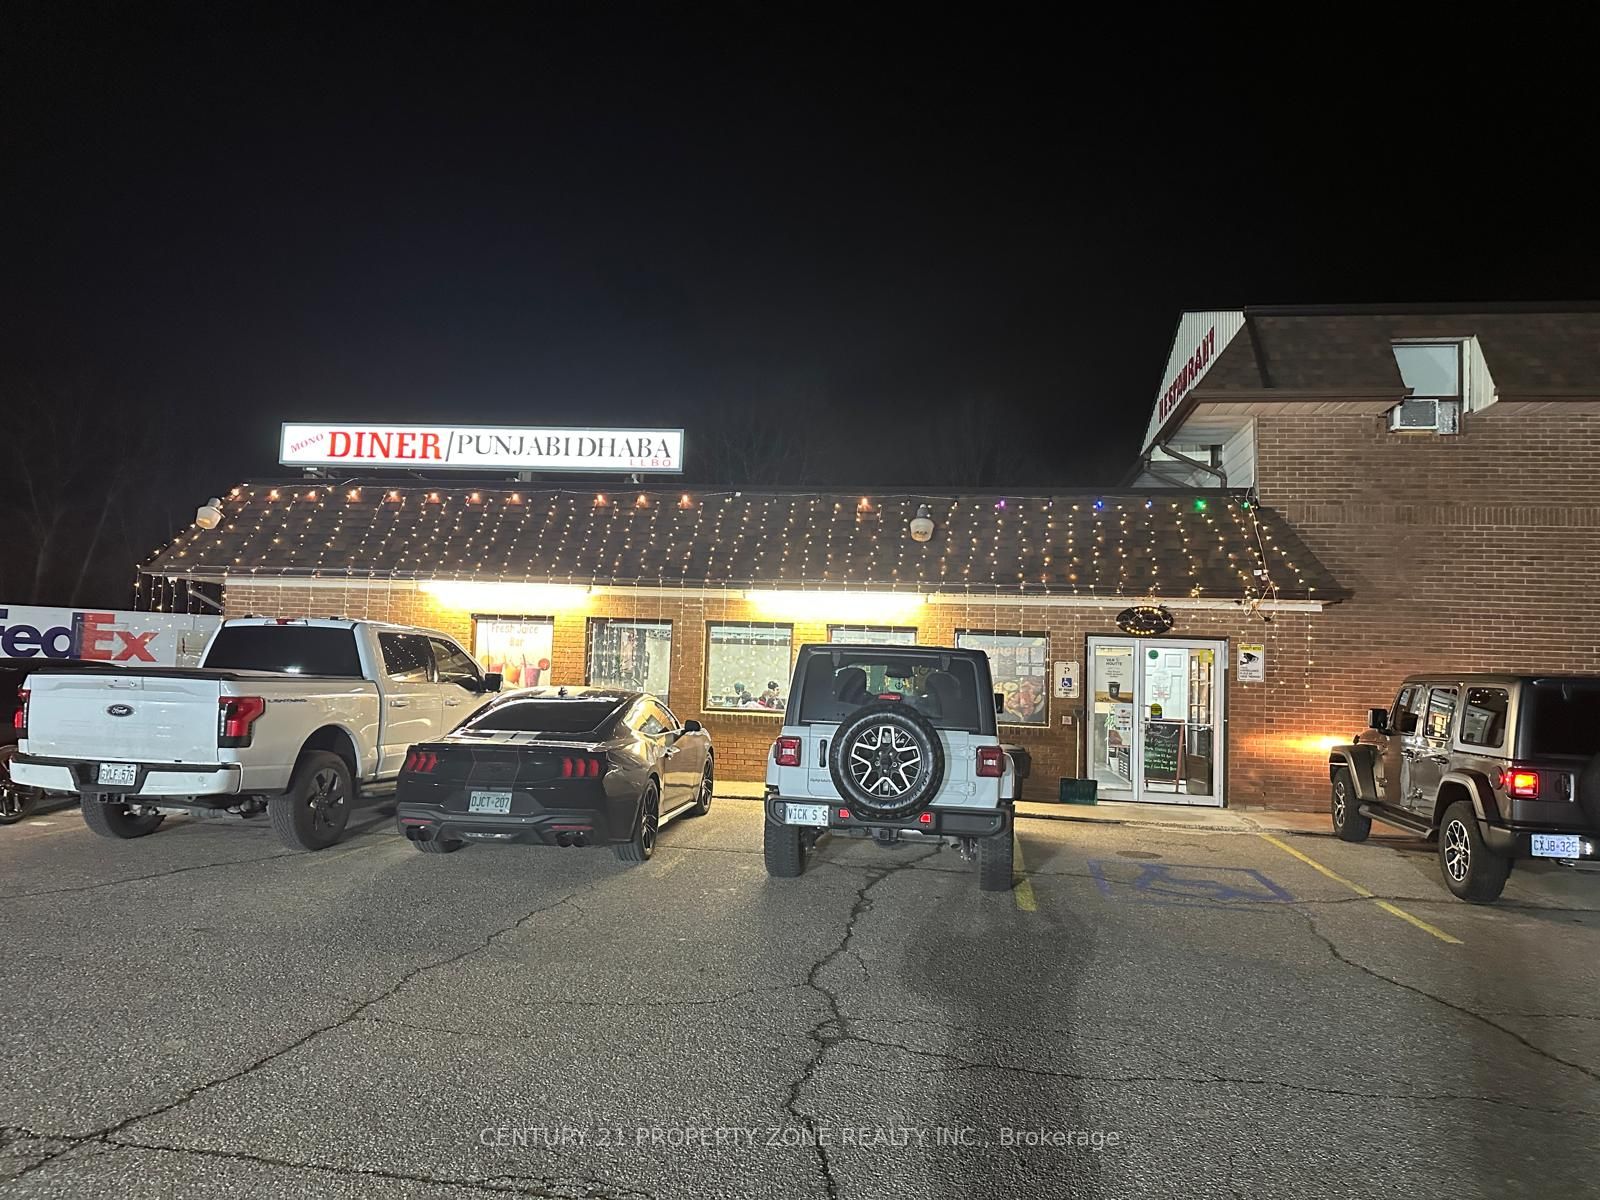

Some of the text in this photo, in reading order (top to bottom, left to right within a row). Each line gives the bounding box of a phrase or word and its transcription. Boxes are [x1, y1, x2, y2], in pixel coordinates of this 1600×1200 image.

[1158, 326, 1215, 424] RESTAURANT
[290, 433, 324, 452] MONO
[327, 431, 442, 460] DINER
[577, 437, 671, 458] DHABA
[0, 608, 159, 662] edEx
[111, 706, 128, 714] Ford
[122, 769, 135, 781] 576
[471, 796, 510, 808] DJCT 207
[788, 808, 807, 820] VICK
[1533, 840, 1577, 852] CXJB 325
